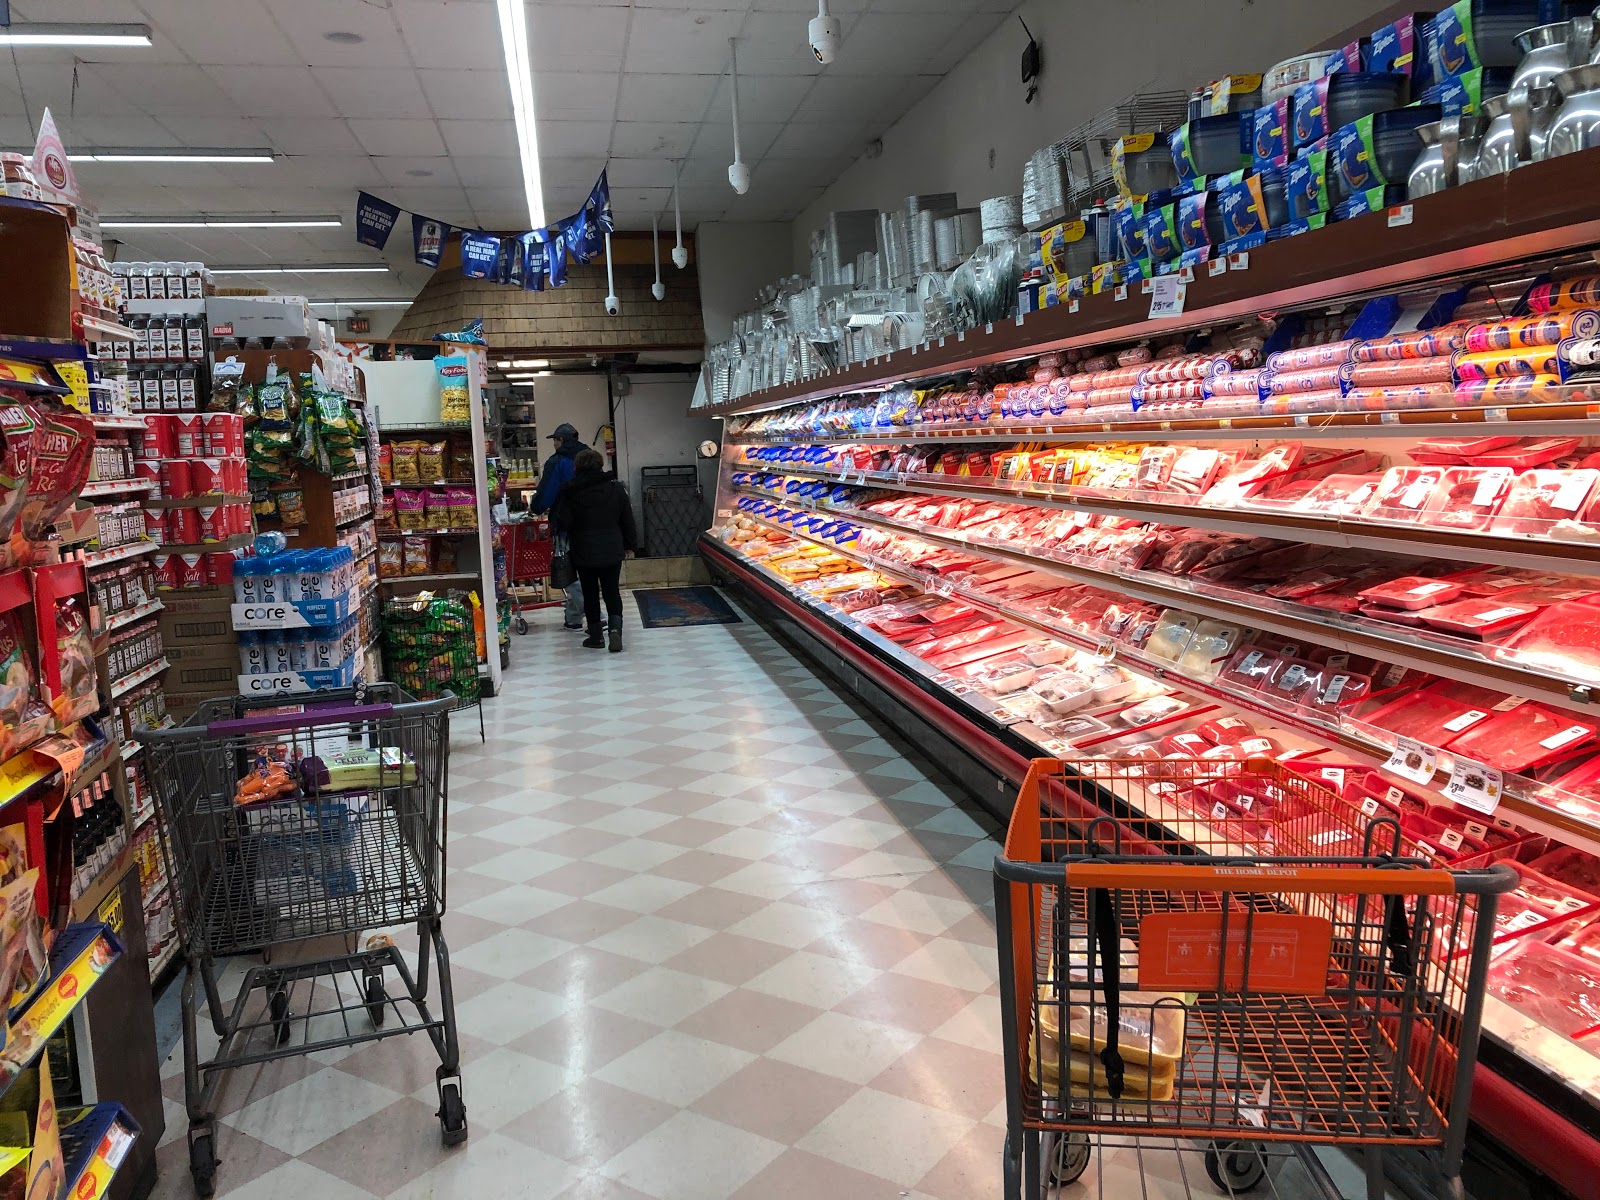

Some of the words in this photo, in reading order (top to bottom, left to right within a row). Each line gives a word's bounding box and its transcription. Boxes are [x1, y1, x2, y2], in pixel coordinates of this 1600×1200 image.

[1373, 33, 1396, 57] Ziploc
[1255, 112, 1272, 132] Ziploc
[1224, 190, 1242, 213] Ziploc
[1348, 201, 1367, 219] Ziploc
[361, 217, 375, 227] CAN
[364, 211, 378, 221] REAL
[468, 252, 480, 260] CAN
[469, 246, 482, 254] REAL
[482, 248, 496, 256] MAN
[441, 367, 453, 375] Key
[153, 571, 170, 582] Salt
[183, 570, 201, 582] Salt
[243, 580, 256, 603] ore
[263, 579, 275, 603] ore
[301, 577, 310, 600] ore
[312, 576, 321, 599] ore
[244, 608, 285, 620] core
[249, 649, 261, 674] ore
[278, 648, 288, 673] ore
[319, 645, 329, 668] ore
[250, 677, 292, 690] core
[1236, 868, 1264, 876] HOME
[1266, 868, 1298, 877] DEPOT
